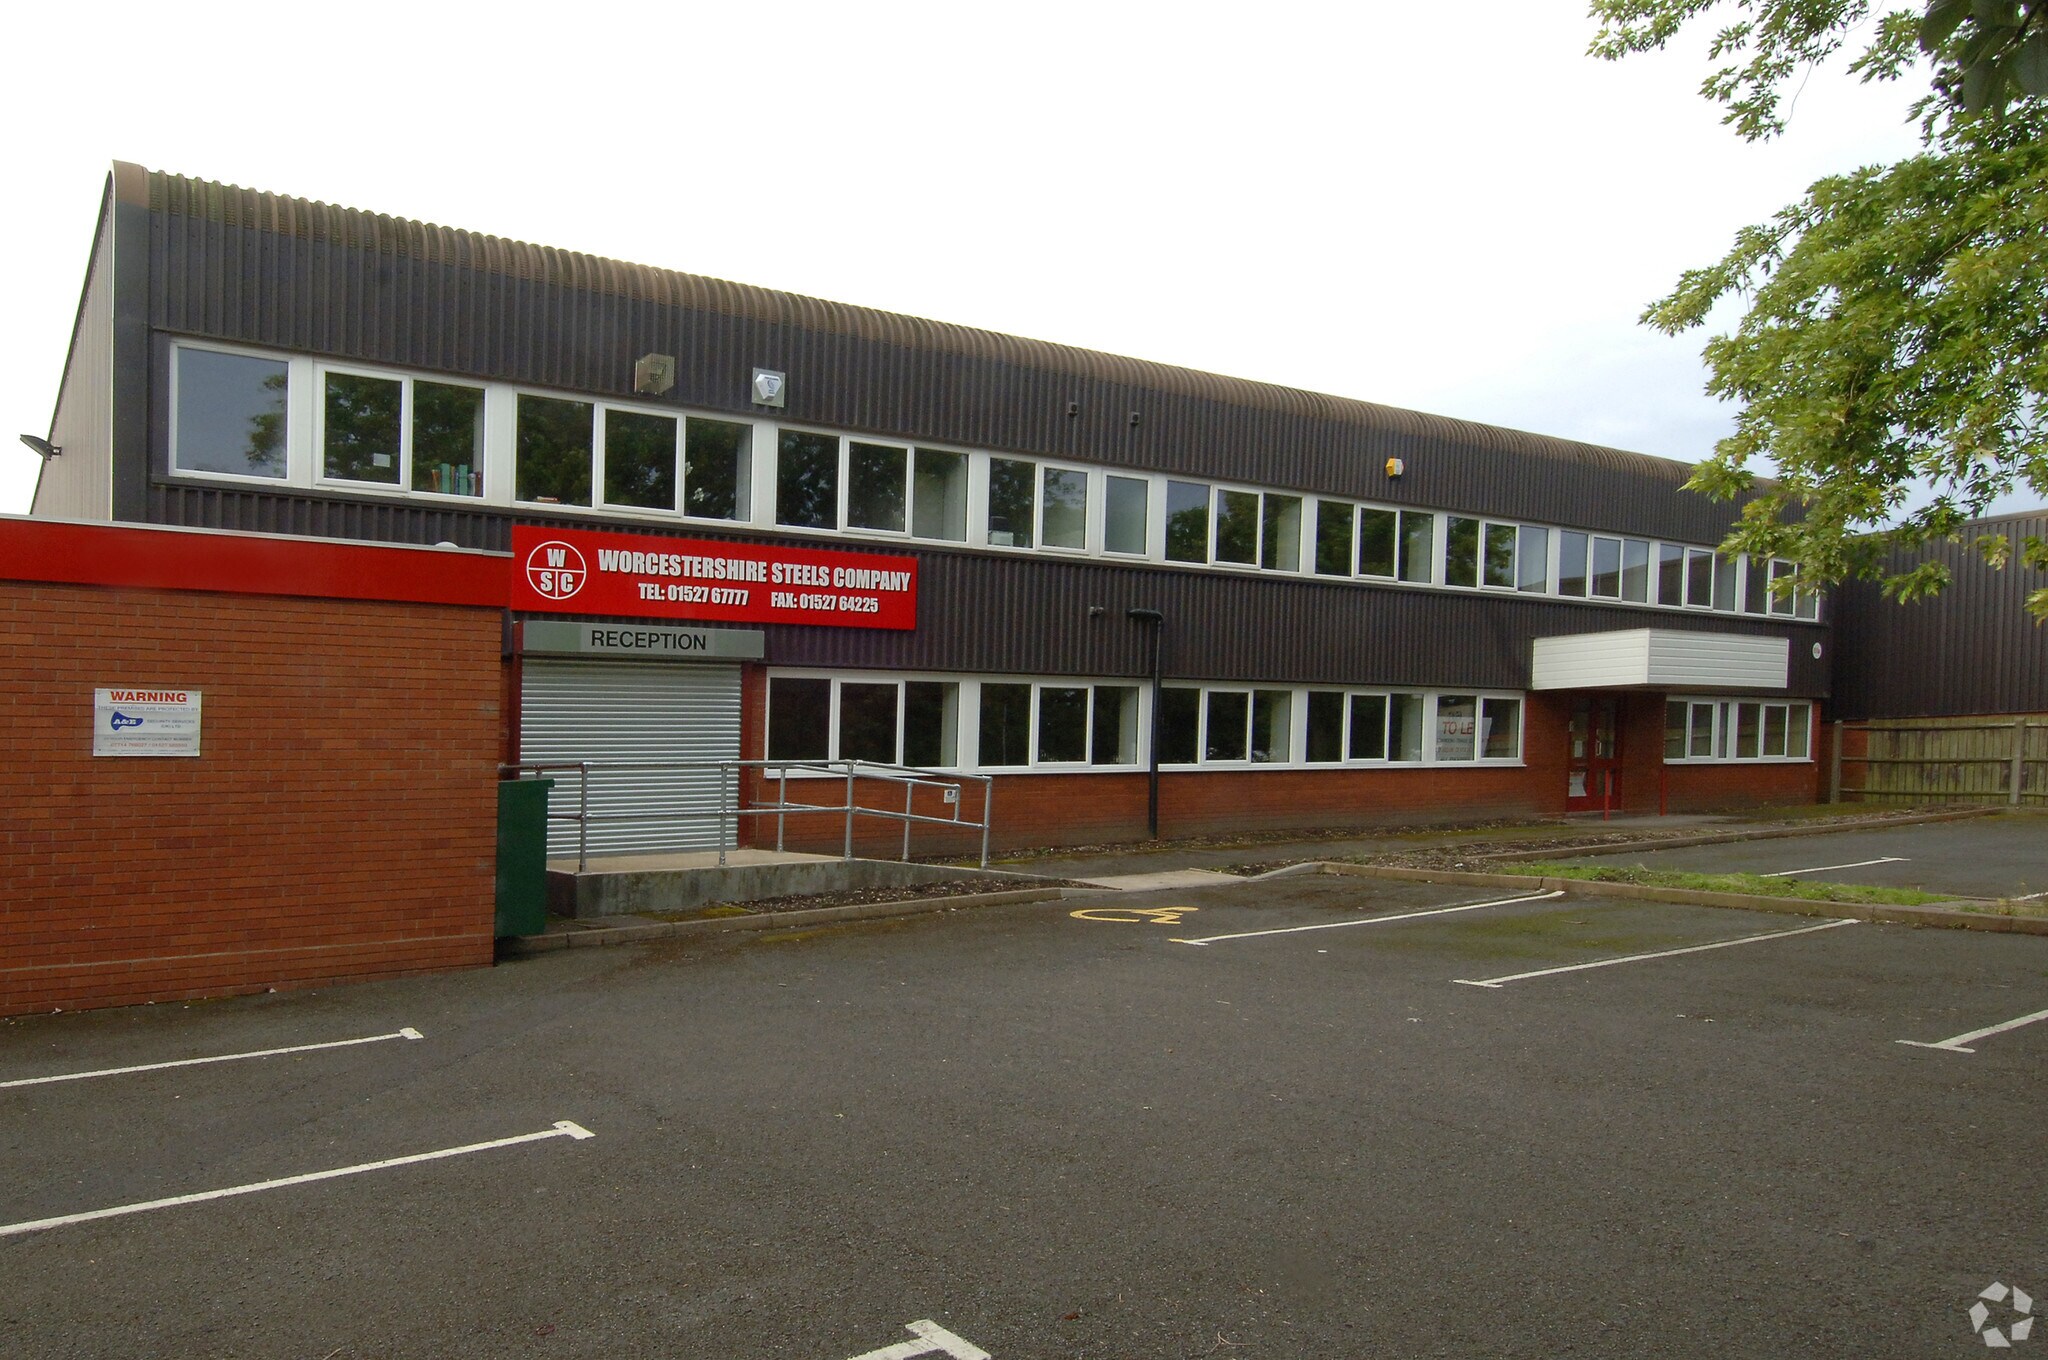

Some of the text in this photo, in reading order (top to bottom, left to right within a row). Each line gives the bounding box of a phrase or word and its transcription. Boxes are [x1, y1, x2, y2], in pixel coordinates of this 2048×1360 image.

[547, 549, 566, 567] W
[598, 549, 911, 592] WORCESTERSHIRE STEELS COMPANY
[540, 572, 574, 593] S C
[638, 583, 749, 606] TEL: 01527 67777
[771, 592, 879, 613] FAX: 01527 64225
[591, 629, 706, 651] RECEPTION
[110, 691, 187, 702] WARNING
[1443, 721, 1474, 735] TO LE
